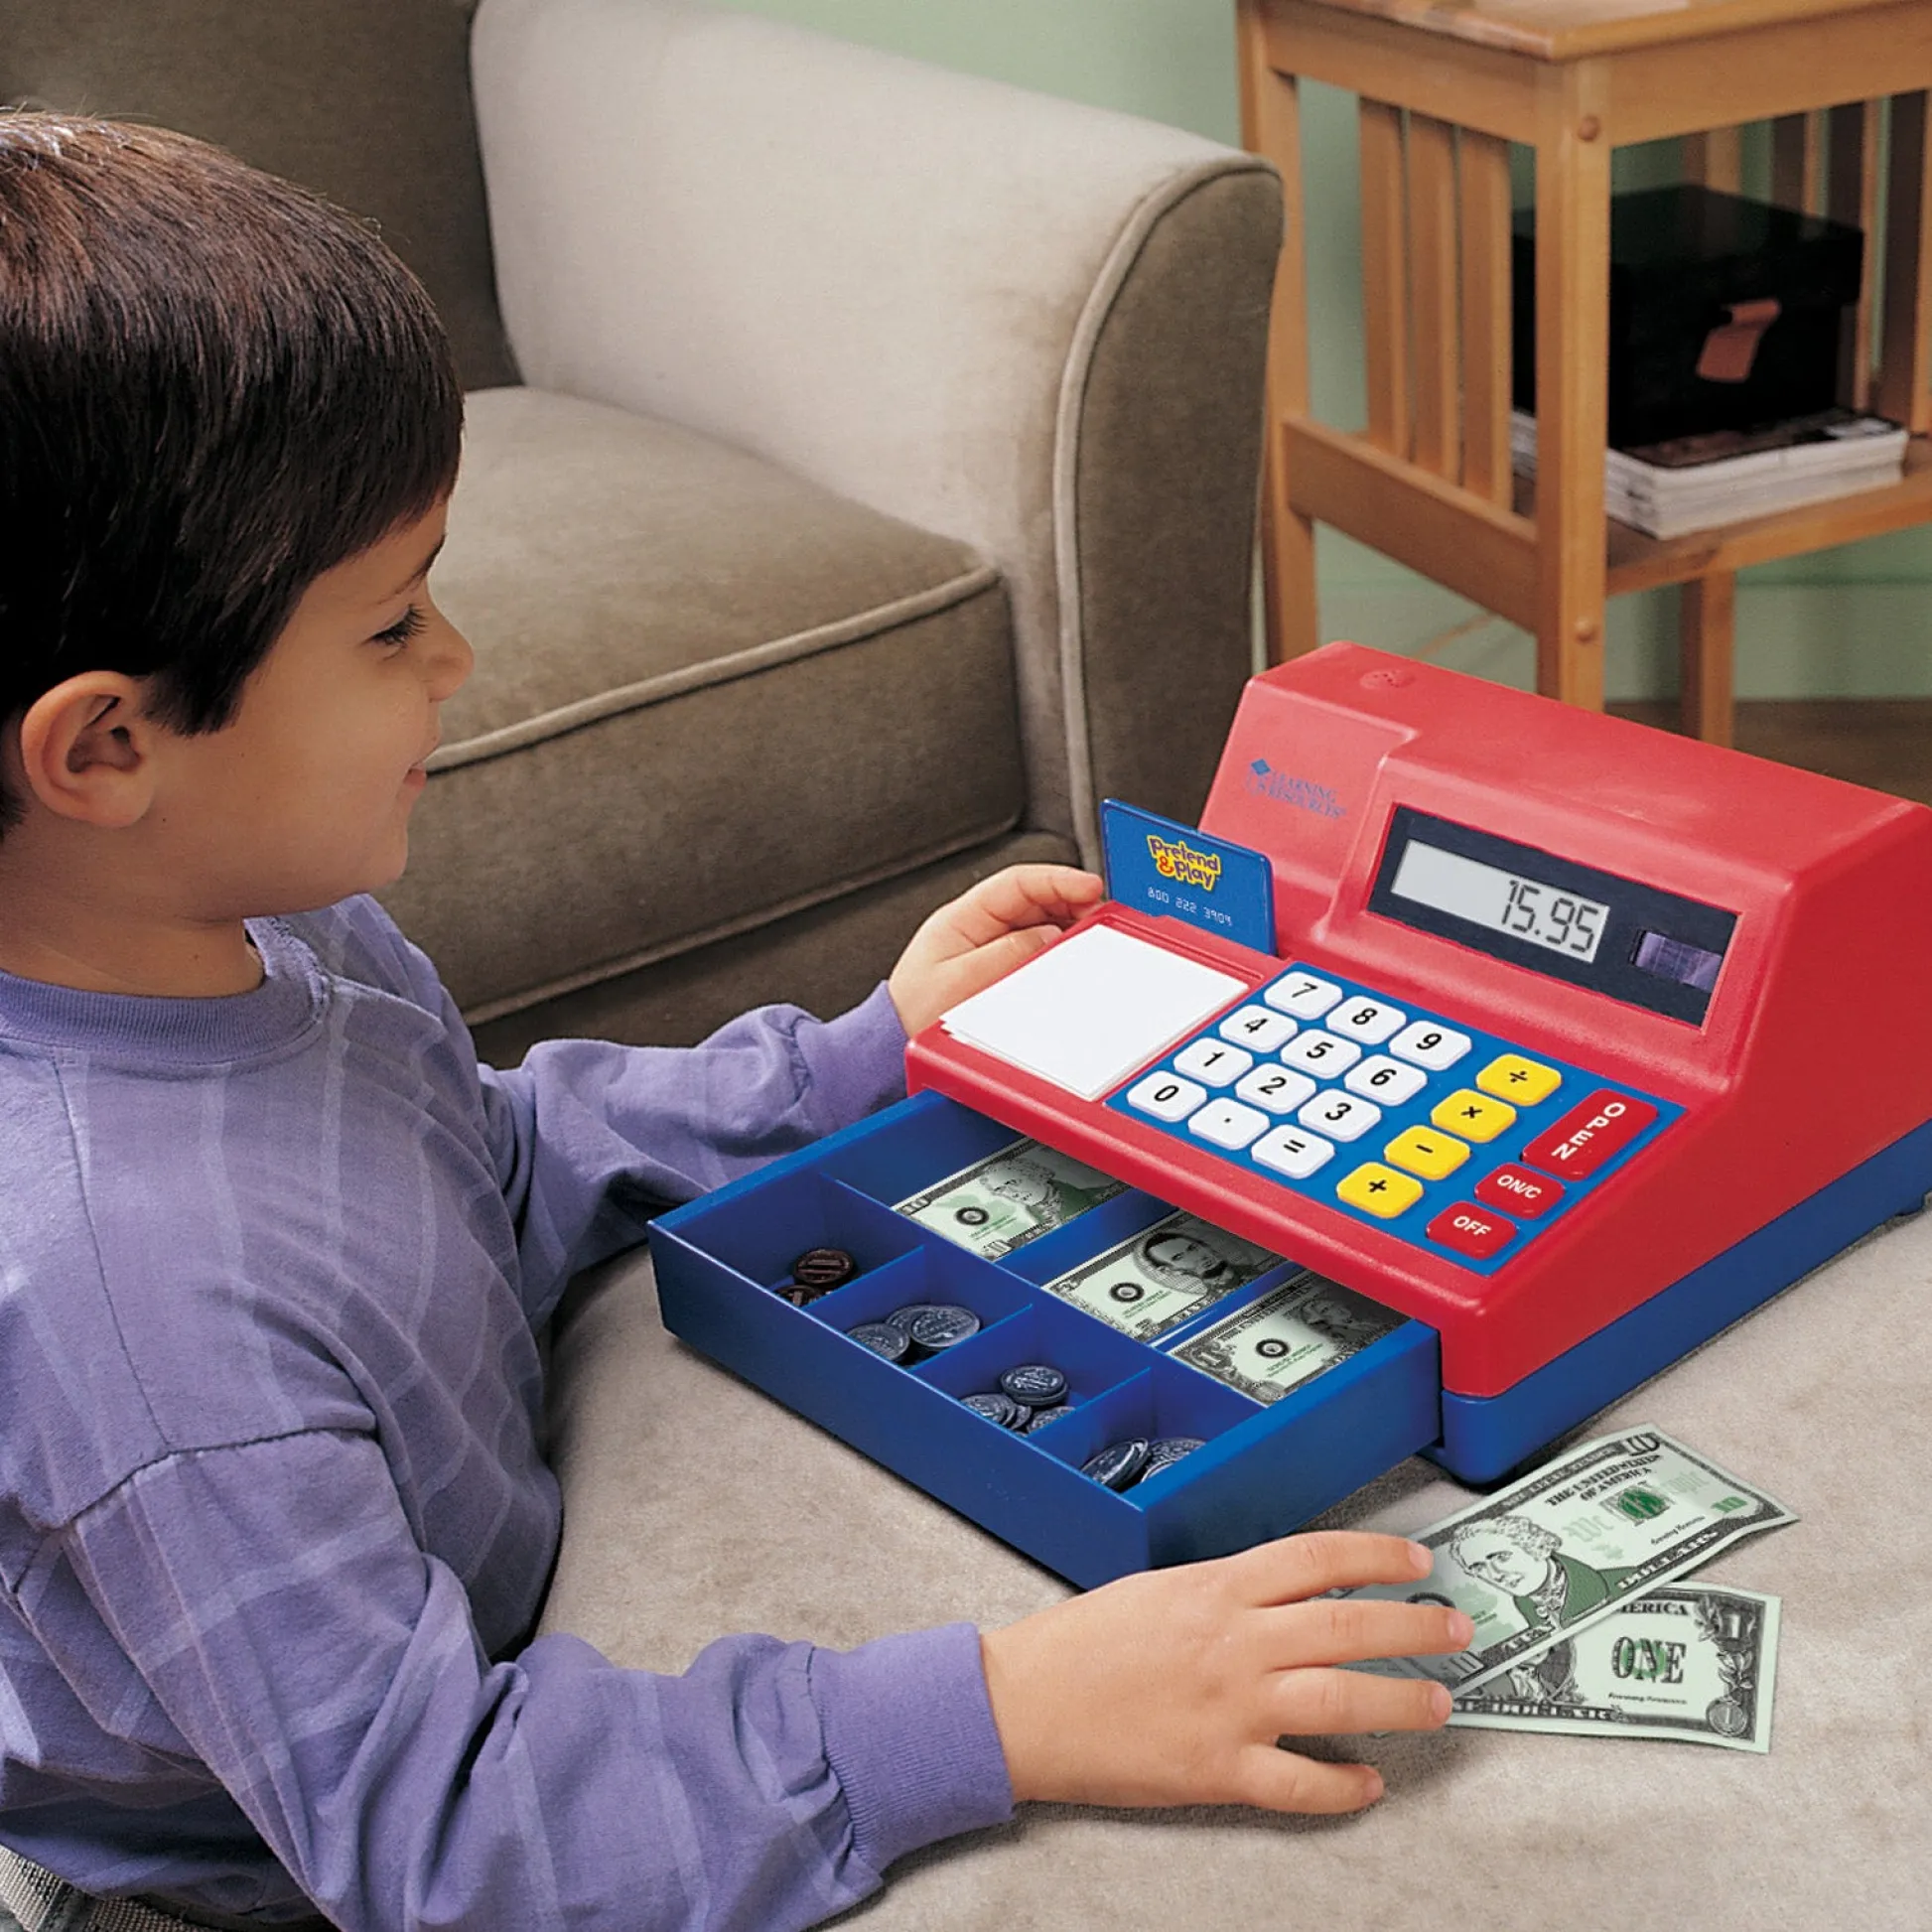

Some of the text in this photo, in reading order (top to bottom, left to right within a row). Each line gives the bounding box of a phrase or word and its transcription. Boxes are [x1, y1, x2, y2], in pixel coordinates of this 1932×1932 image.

[1148, 837, 1220, 873] Pretend
[1159, 856, 1214, 890] & Play
[1500, 880, 1600, 954] 15.95
[1291, 982, 1318, 999] 7
[1244, 1017, 1268, 1034] 4
[1351, 1007, 1378, 1026] 8
[1306, 1040, 1334, 1058] 5
[1416, 1033, 1443, 1051] 9
[1203, 1051, 1223, 1067] 1
[1258, 1076, 1287, 1095] 2
[1370, 1068, 1397, 1086] 6
[1154, 1085, 1179, 1103] 0
[1323, 1102, 1352, 1122] 3
[1551, 1102, 1626, 1161] OPEN
[1496, 1173, 1543, 1199] ON/C
[1452, 1215, 1492, 1236] OFF
[1625, 1432, 1661, 1457] 10
[1610, 1636, 1688, 1685] ONE
